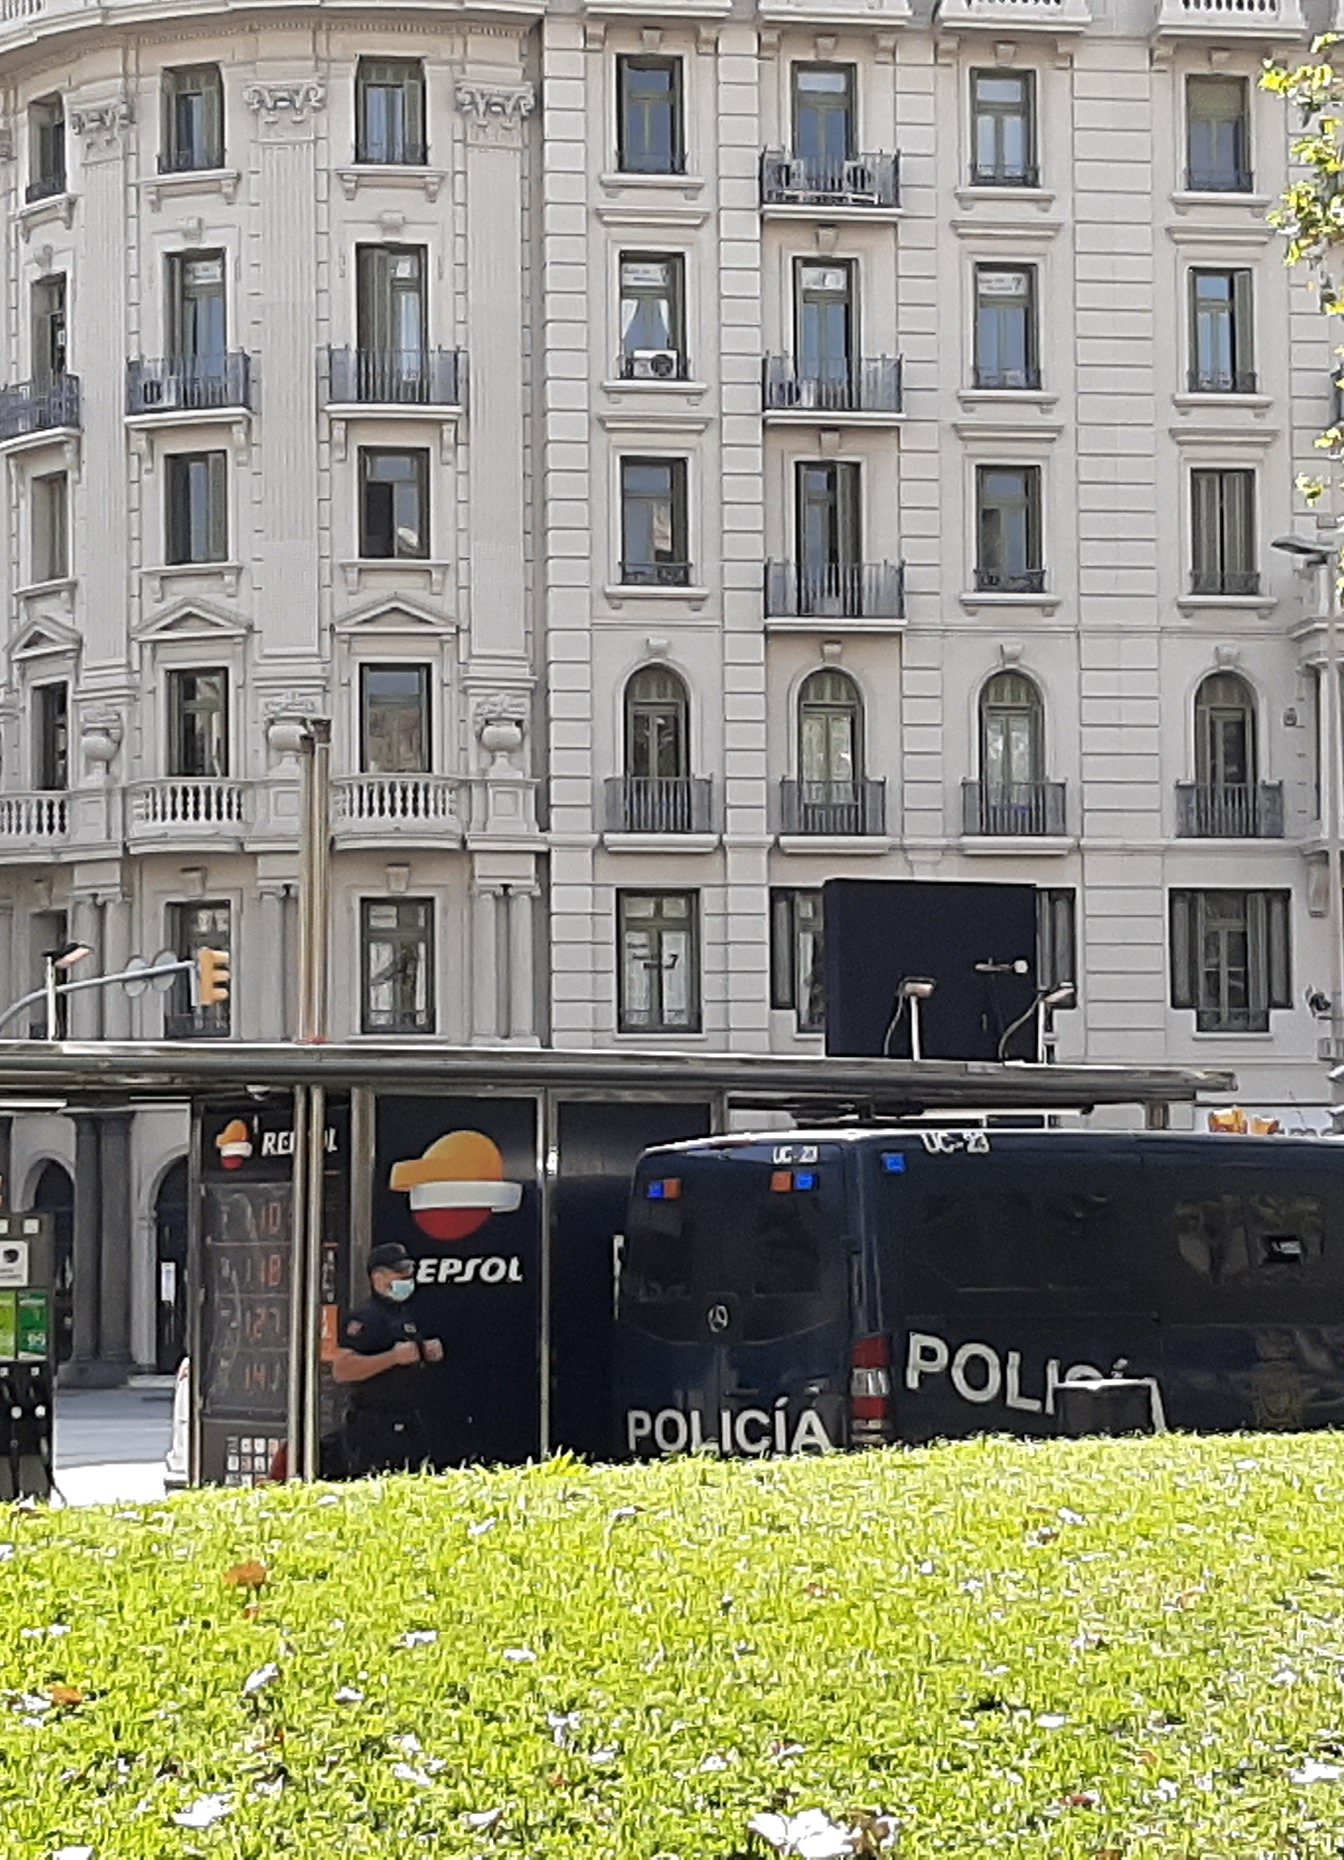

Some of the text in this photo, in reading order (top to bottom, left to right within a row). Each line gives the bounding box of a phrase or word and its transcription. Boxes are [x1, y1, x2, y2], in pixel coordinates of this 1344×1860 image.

[261, 1127, 338, 1157] REL
[416, 1256, 523, 1283] EPSOL
[906, 1331, 1168, 1434] POLI
